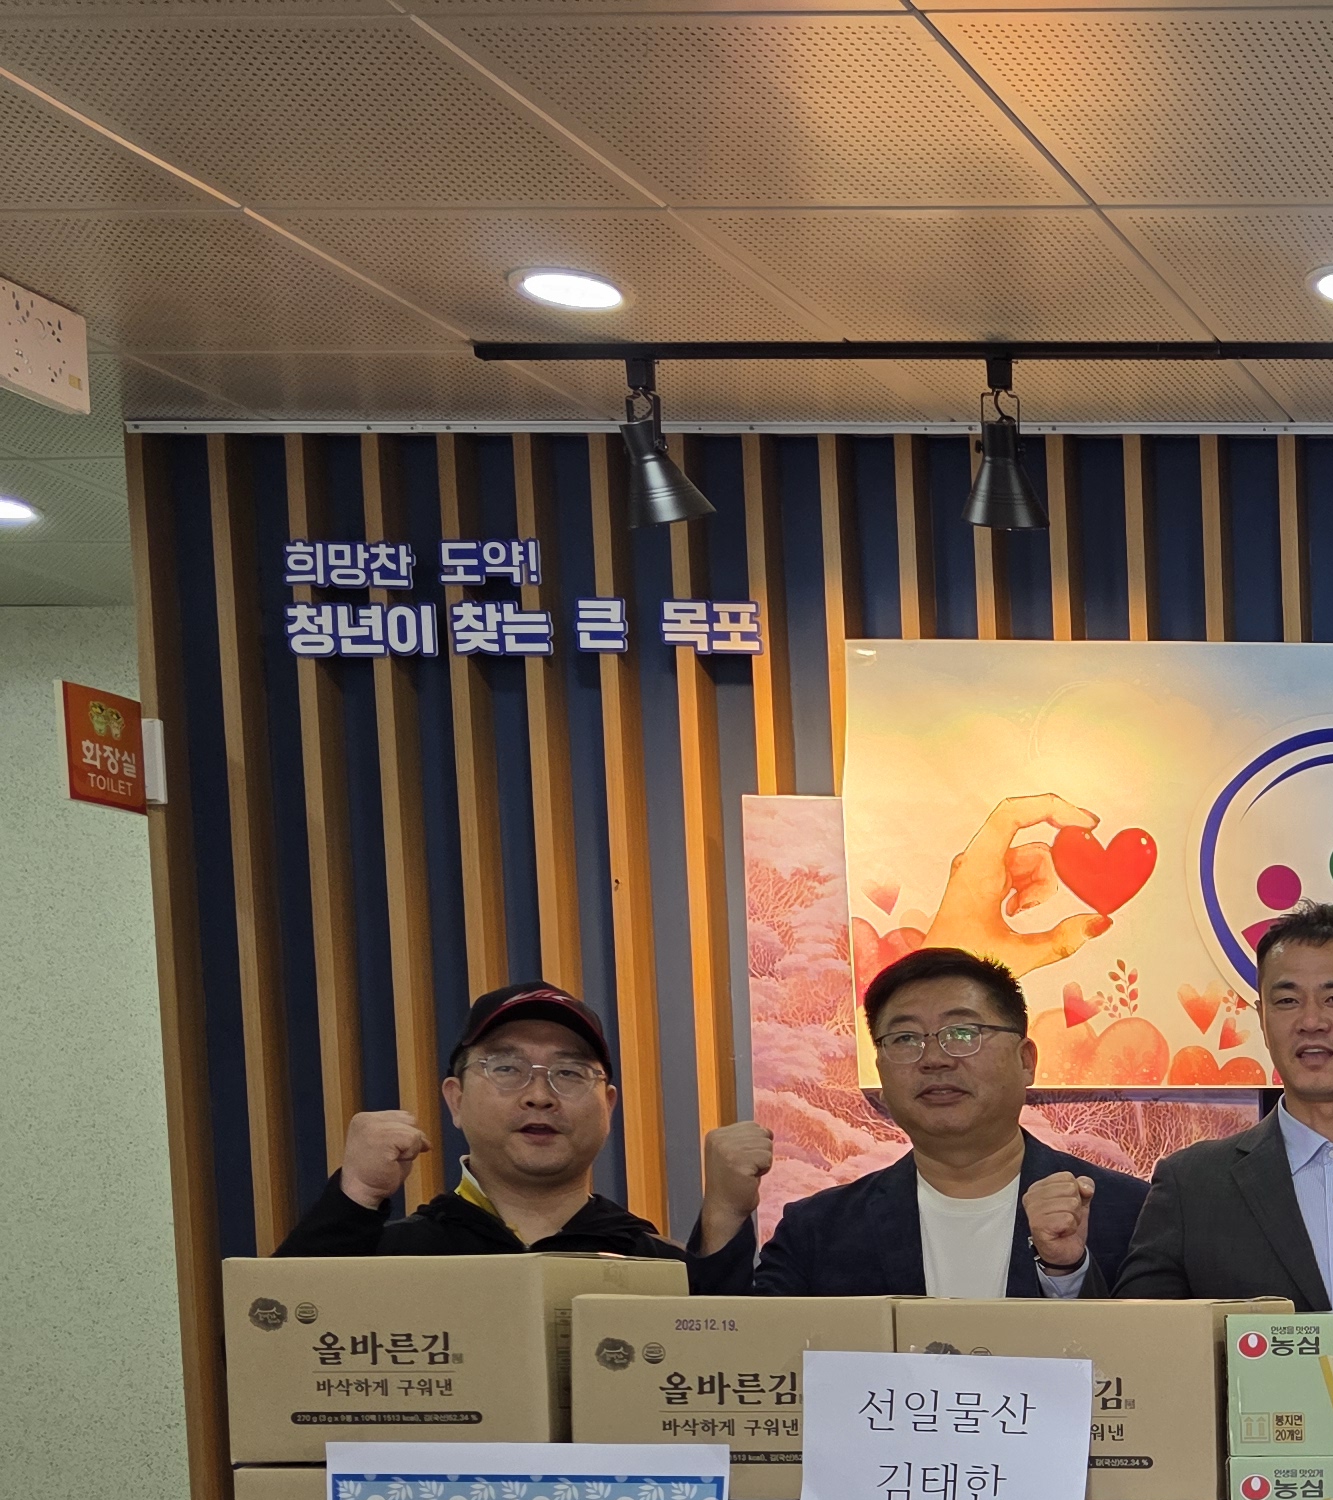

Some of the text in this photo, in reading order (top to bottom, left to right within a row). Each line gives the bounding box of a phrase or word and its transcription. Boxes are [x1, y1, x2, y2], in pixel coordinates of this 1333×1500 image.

[285, 538, 540, 588] 희망찬 도약!
[285, 599, 761, 655] 청년이 찾는 큰 목포
[82, 739, 137, 779] 화장실
[88, 773, 133, 797] TOILET
[311, 1331, 451, 1366] 올바른김
[1270, 1335, 1321, 1357] 농심
[316, 1378, 454, 1398] 바삭하게 구워낸
[658, 1371, 798, 1406] 올바른김
[857, 1387, 1037, 1436] 선일물산
[1274, 1414, 1303, 1427] 봉지면
[662, 1418, 800, 1438] 바삭하게 구워낸
[1275, 1428, 1304, 1442] 20개입
